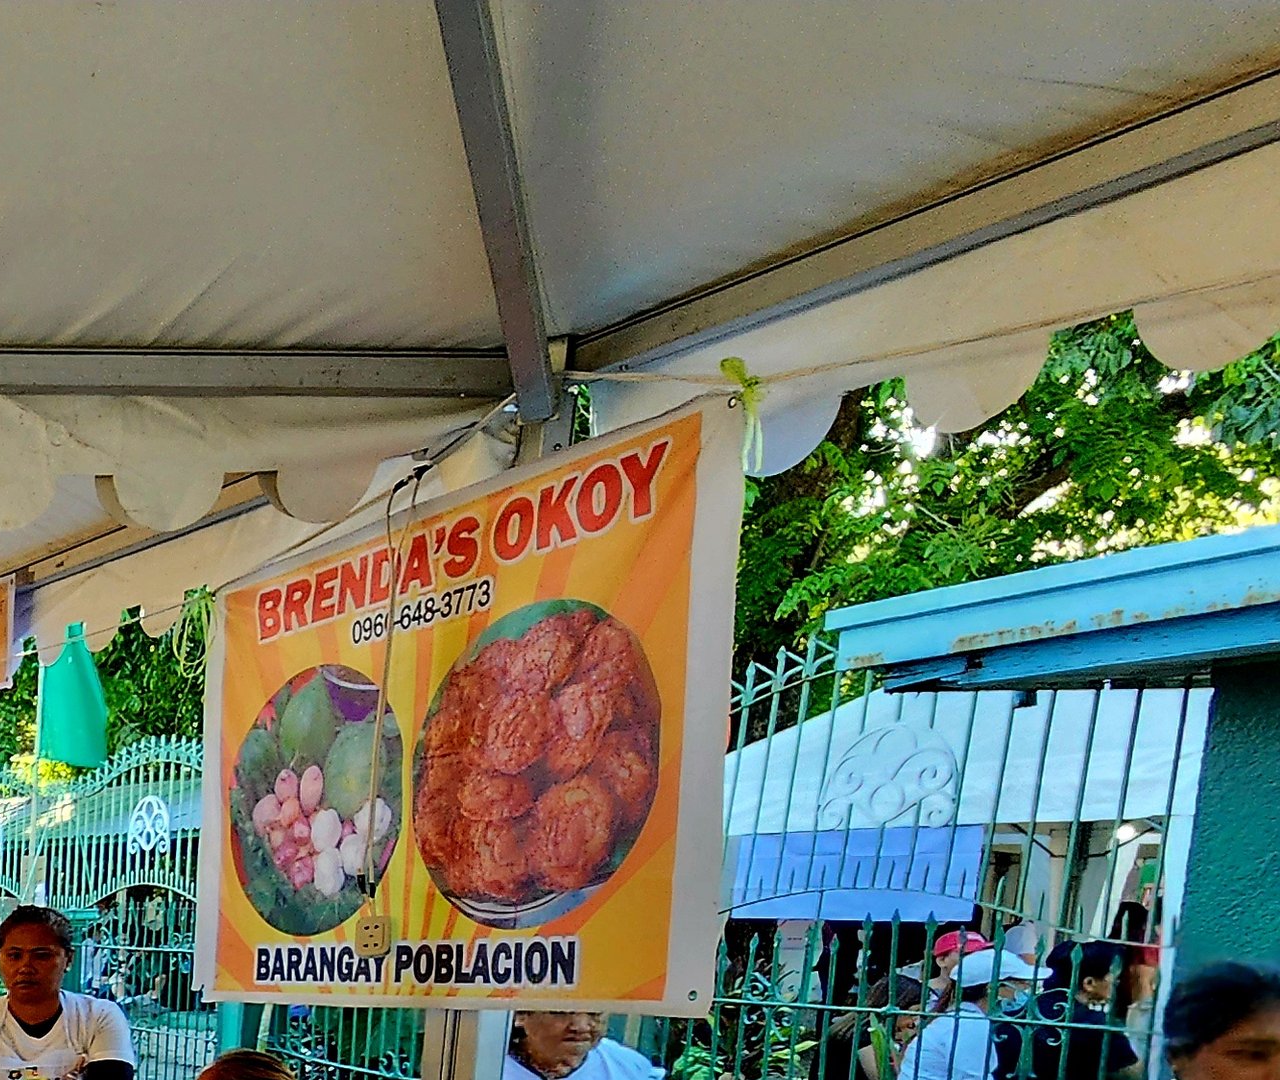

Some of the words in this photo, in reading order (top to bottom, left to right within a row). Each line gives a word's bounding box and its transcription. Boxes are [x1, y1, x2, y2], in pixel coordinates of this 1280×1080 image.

[258, 516, 481, 643] BRENDA'S
[494, 441, 669, 561] OKOY
[256, 944, 385, 983] BARANGAY
[394, 941, 576, 984] POBLACION
